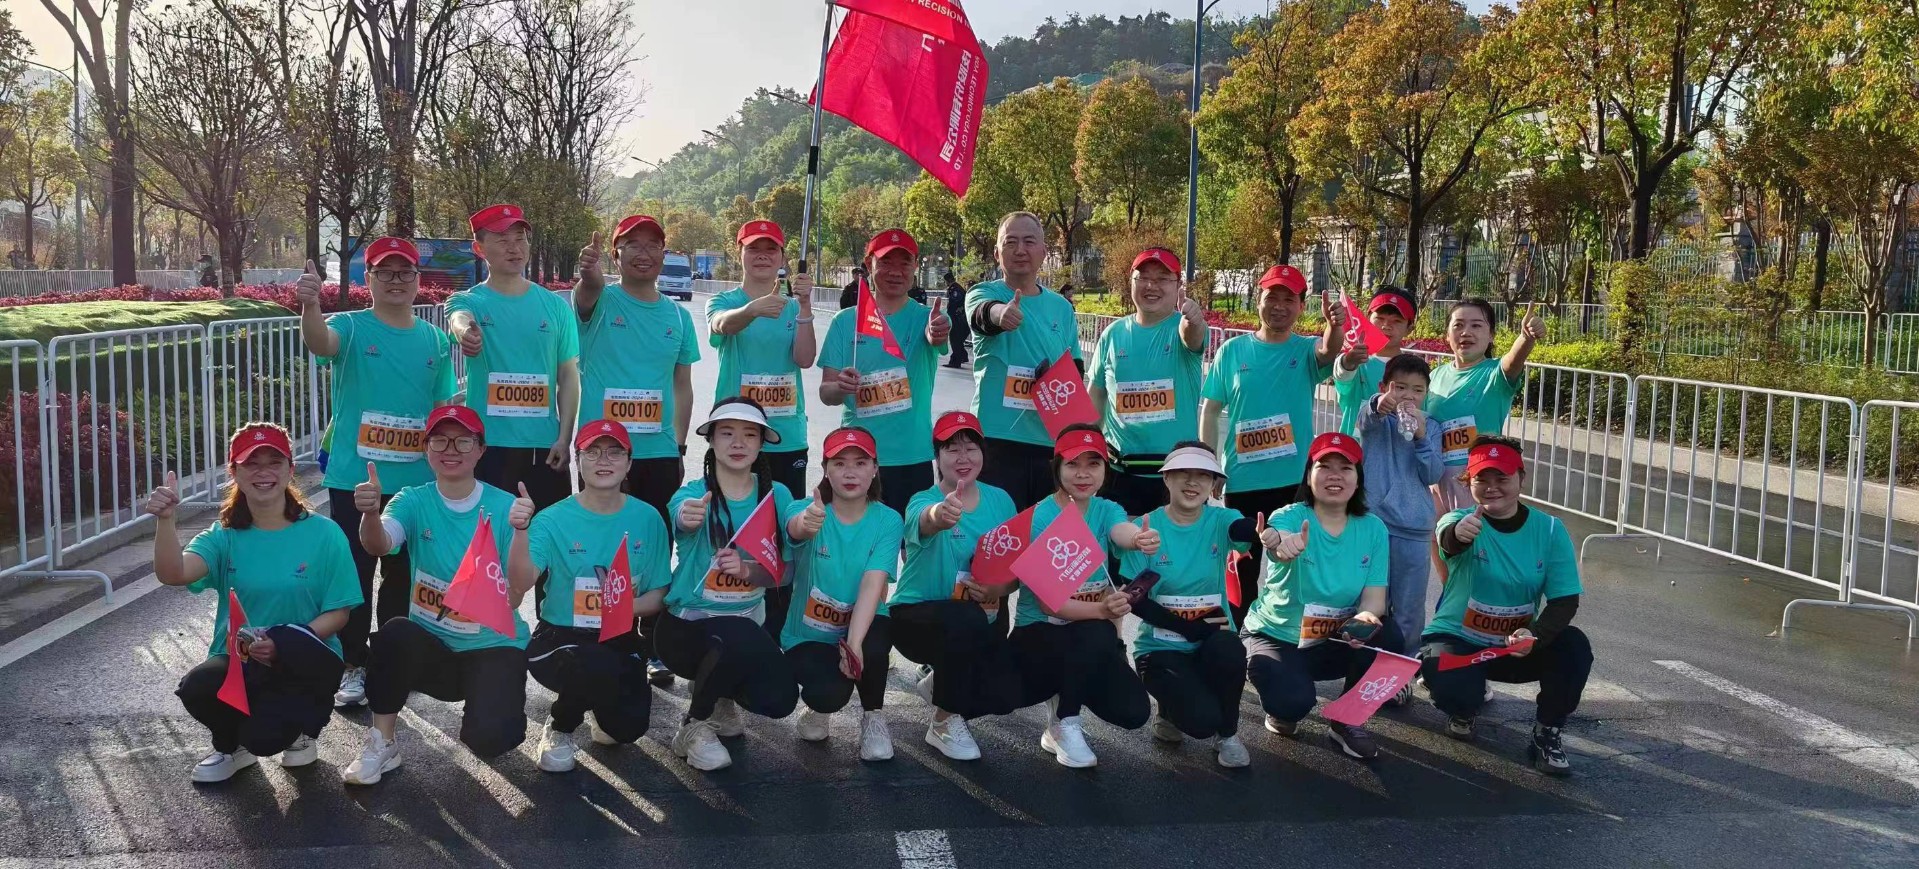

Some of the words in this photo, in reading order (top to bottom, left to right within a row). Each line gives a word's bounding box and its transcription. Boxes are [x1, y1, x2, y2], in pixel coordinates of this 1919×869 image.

[911, 0, 963, 23] RECISION
[496, 386, 544, 403] C00089
[1122, 391, 1167, 409] C01090
[611, 402, 658, 418] C00107
[367, 426, 420, 447] C00108
[1241, 428, 1287, 449] C00090
